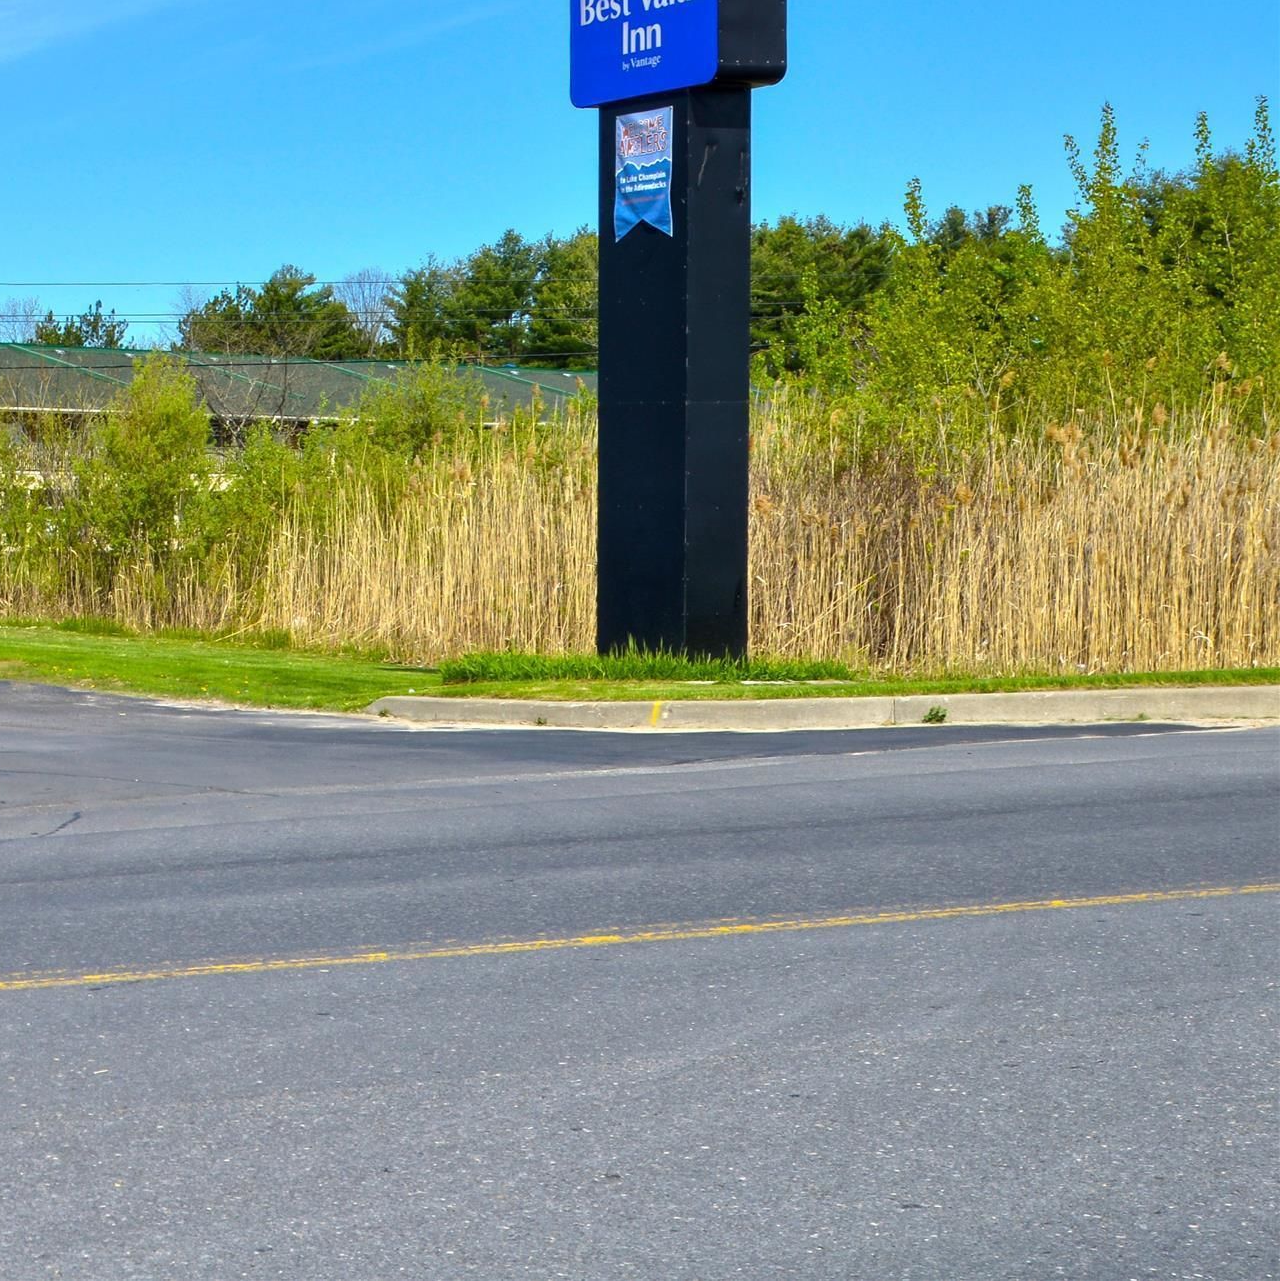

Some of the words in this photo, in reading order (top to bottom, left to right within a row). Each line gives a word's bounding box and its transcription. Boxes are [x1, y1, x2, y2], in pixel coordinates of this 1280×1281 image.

[622, 21, 662, 55] Inn
[622, 61, 630, 72] by
[630, 55, 662, 68] Vantage
[638, 171, 666, 182] Champlain
